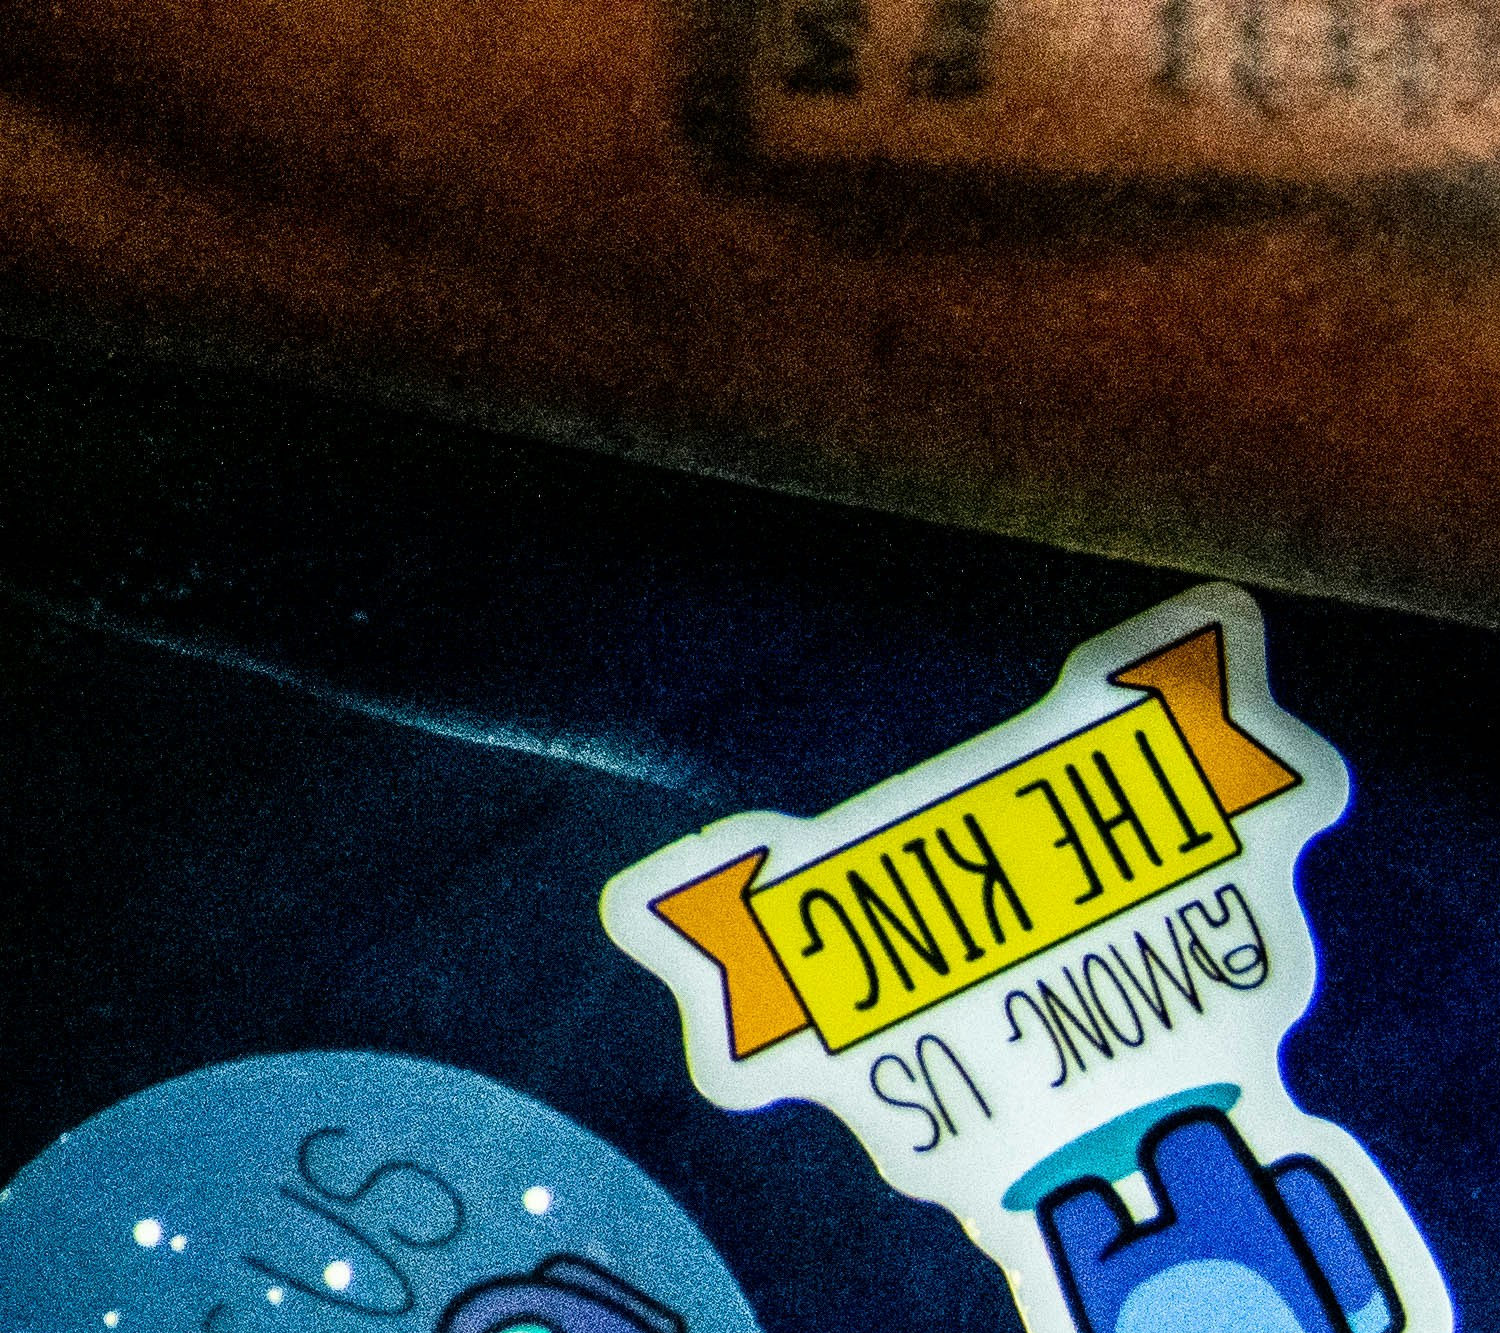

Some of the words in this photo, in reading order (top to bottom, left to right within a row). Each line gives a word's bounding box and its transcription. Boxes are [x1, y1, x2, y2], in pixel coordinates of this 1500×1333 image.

[799, 813, 1033, 1010] KING
[1015, 729, 1213, 905] THE
[1004, 883, 1268, 1087] AMONG
[870, 1033, 992, 1151] US
[242, 1126, 465, 1319] US
